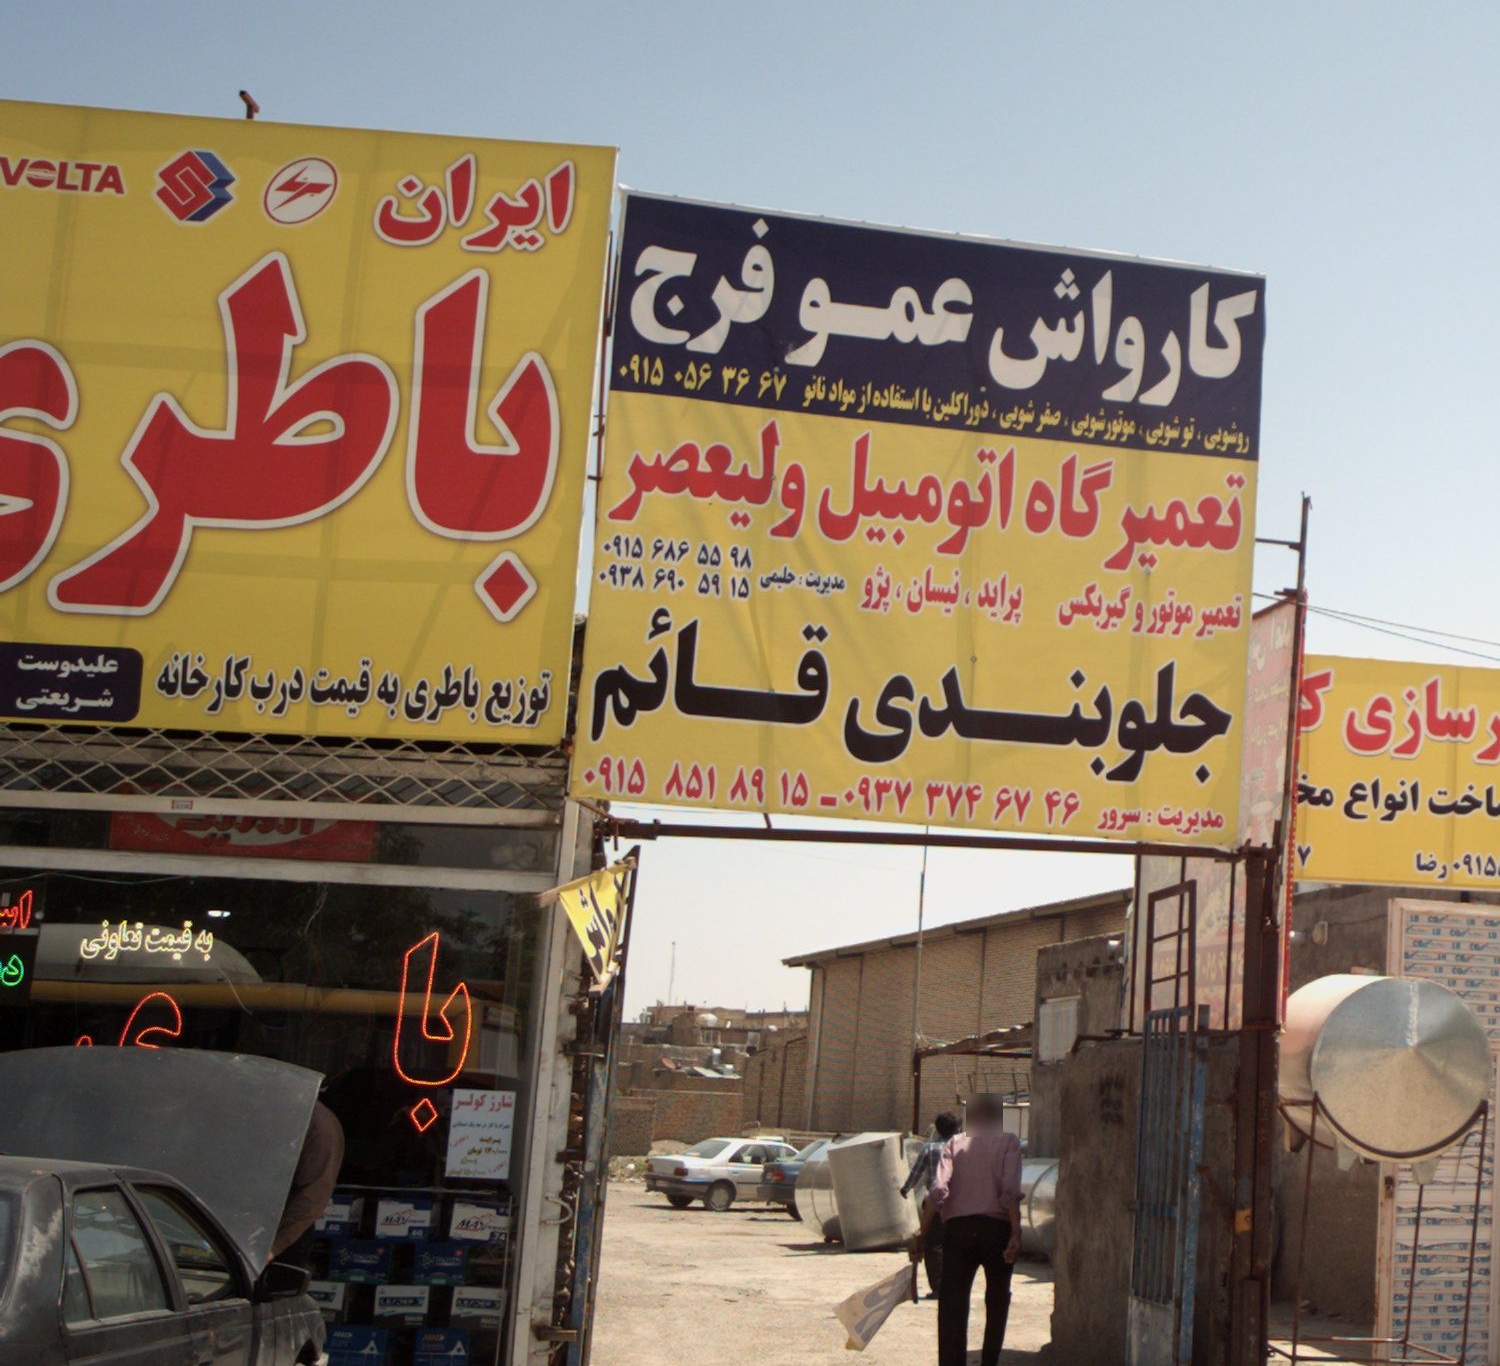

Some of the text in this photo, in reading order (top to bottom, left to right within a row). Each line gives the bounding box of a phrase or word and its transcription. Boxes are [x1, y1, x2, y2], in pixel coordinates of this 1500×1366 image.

[0, 156, 125, 195] VOLTA
[377, 157, 573, 250] ایران
[631, 217, 1257, 407] کارواش عمو فرج
[619, 353, 787, 402] ۰۹۱۵ ۰۵۶ ۳۶ ۶۷
[609, 419, 805, 538] ولیعصر
[818, 432, 1014, 557] اتومبیل
[603, 535, 752, 569] ۰۹۱۵ ۶۸۶ ۵۵ ۹۸
[599, 564, 750, 598] ۰۹۳۸ ۶۹۰ ۵۹ ۱۵
[861, 567, 891, 612] پژو
[906, 568, 960, 614] نیسان
[977, 575, 1023, 622] پراید
[1059, 584, 1242, 638] تعمیر موتور و گیربکس
[251, 668, 304, 715] درب
[310, 658, 371, 715] قیمت
[376, 672, 400, 717] به
[404, 664, 479, 721] باطری
[485, 670, 551, 724] توزیع
[590, 607, 829, 742] قائم
[15, 688, 114, 712] شریعتی
[843, 657, 1233, 786] جلوبندی
[584, 756, 646, 795] ۰۹۱۵
[665, 762, 716, 801] ۸۵۱
[730, 767, 765, 804] ۸۹
[925, 783, 982, 820] ۳۷۴
[994, 787, 1032, 823] ۶۷
[1044, 791, 1081, 826] ۴۶
[1343, 779, 1419, 821] انواع
[1097, 808, 1141, 831] سرور
[1157, 807, 1224, 835] مدیریت
[1415, 853, 1447, 879] رضا
[80, 919, 214, 962] به قیمت تعاونی
